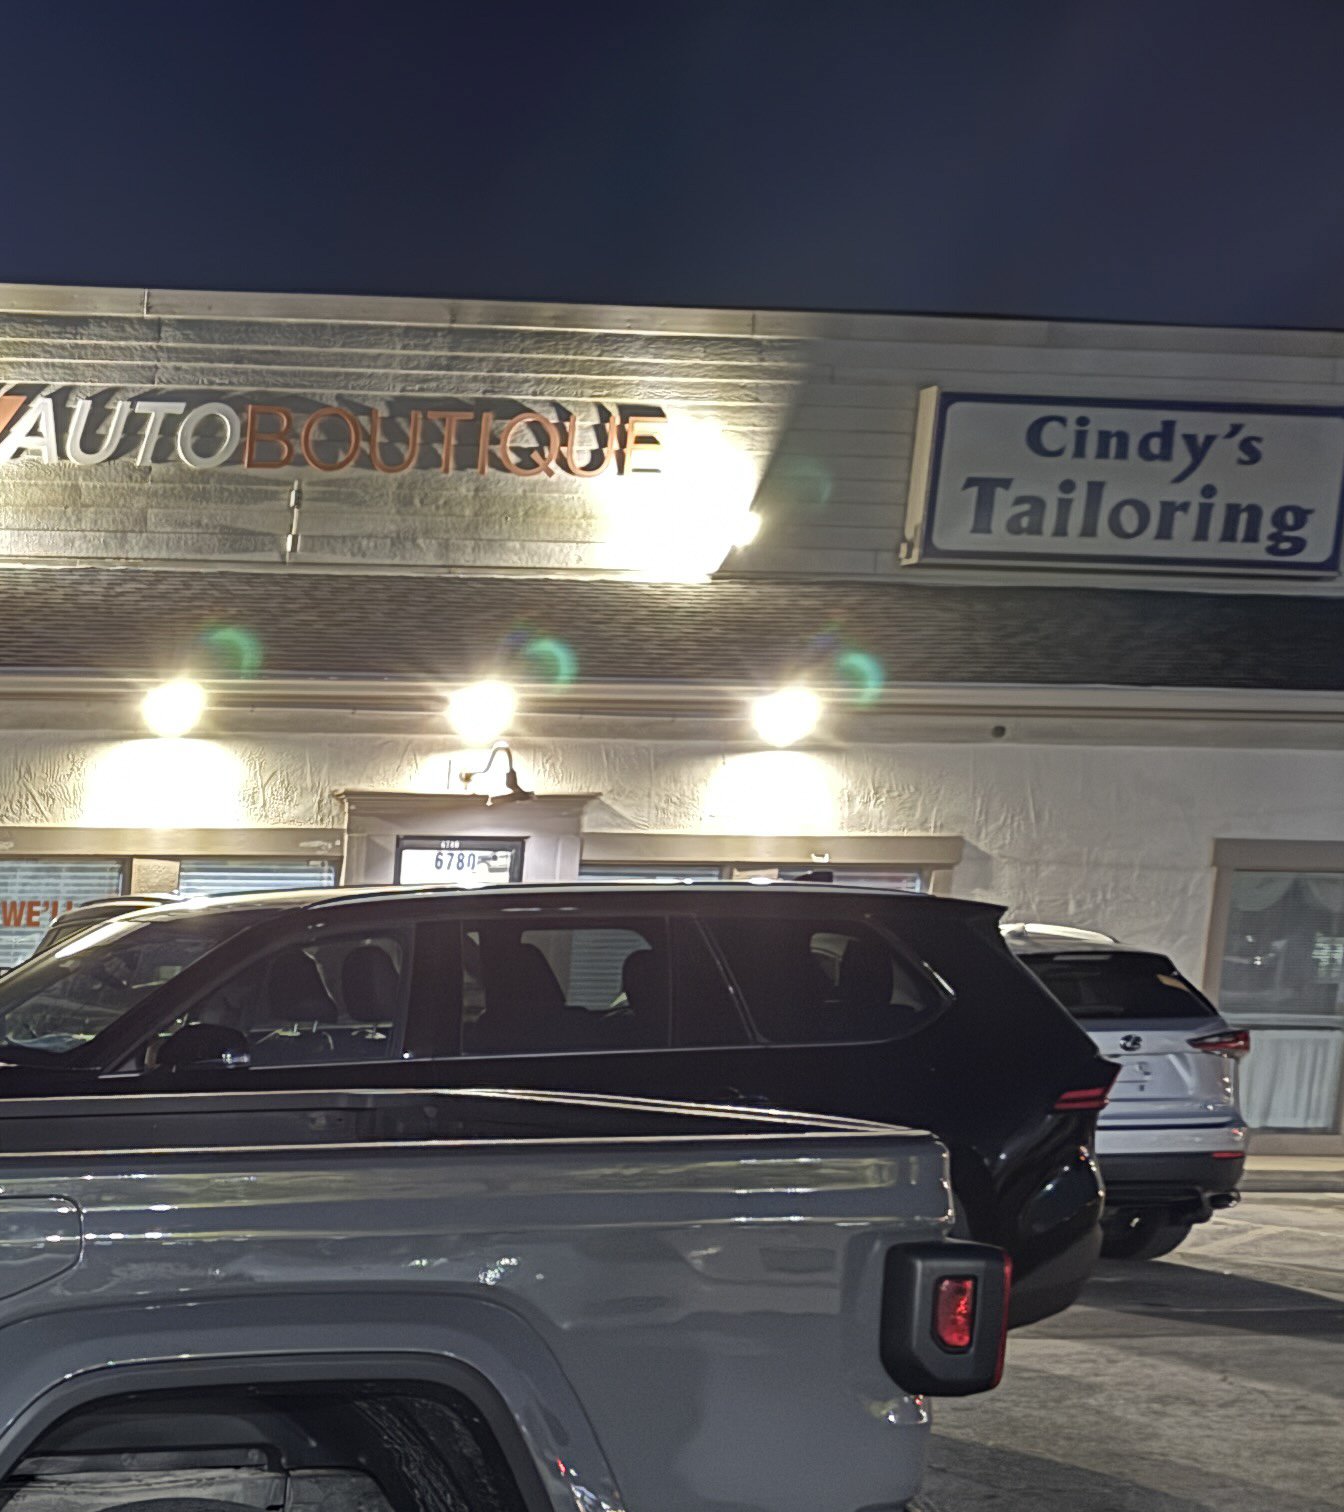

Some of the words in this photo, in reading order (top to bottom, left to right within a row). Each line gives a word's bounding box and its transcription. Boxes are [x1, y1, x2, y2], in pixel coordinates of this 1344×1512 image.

[1025, 415, 1264, 485] Cindy's
[961, 477, 1315, 557] Tailoring
[434, 852, 476, 871] 6780
